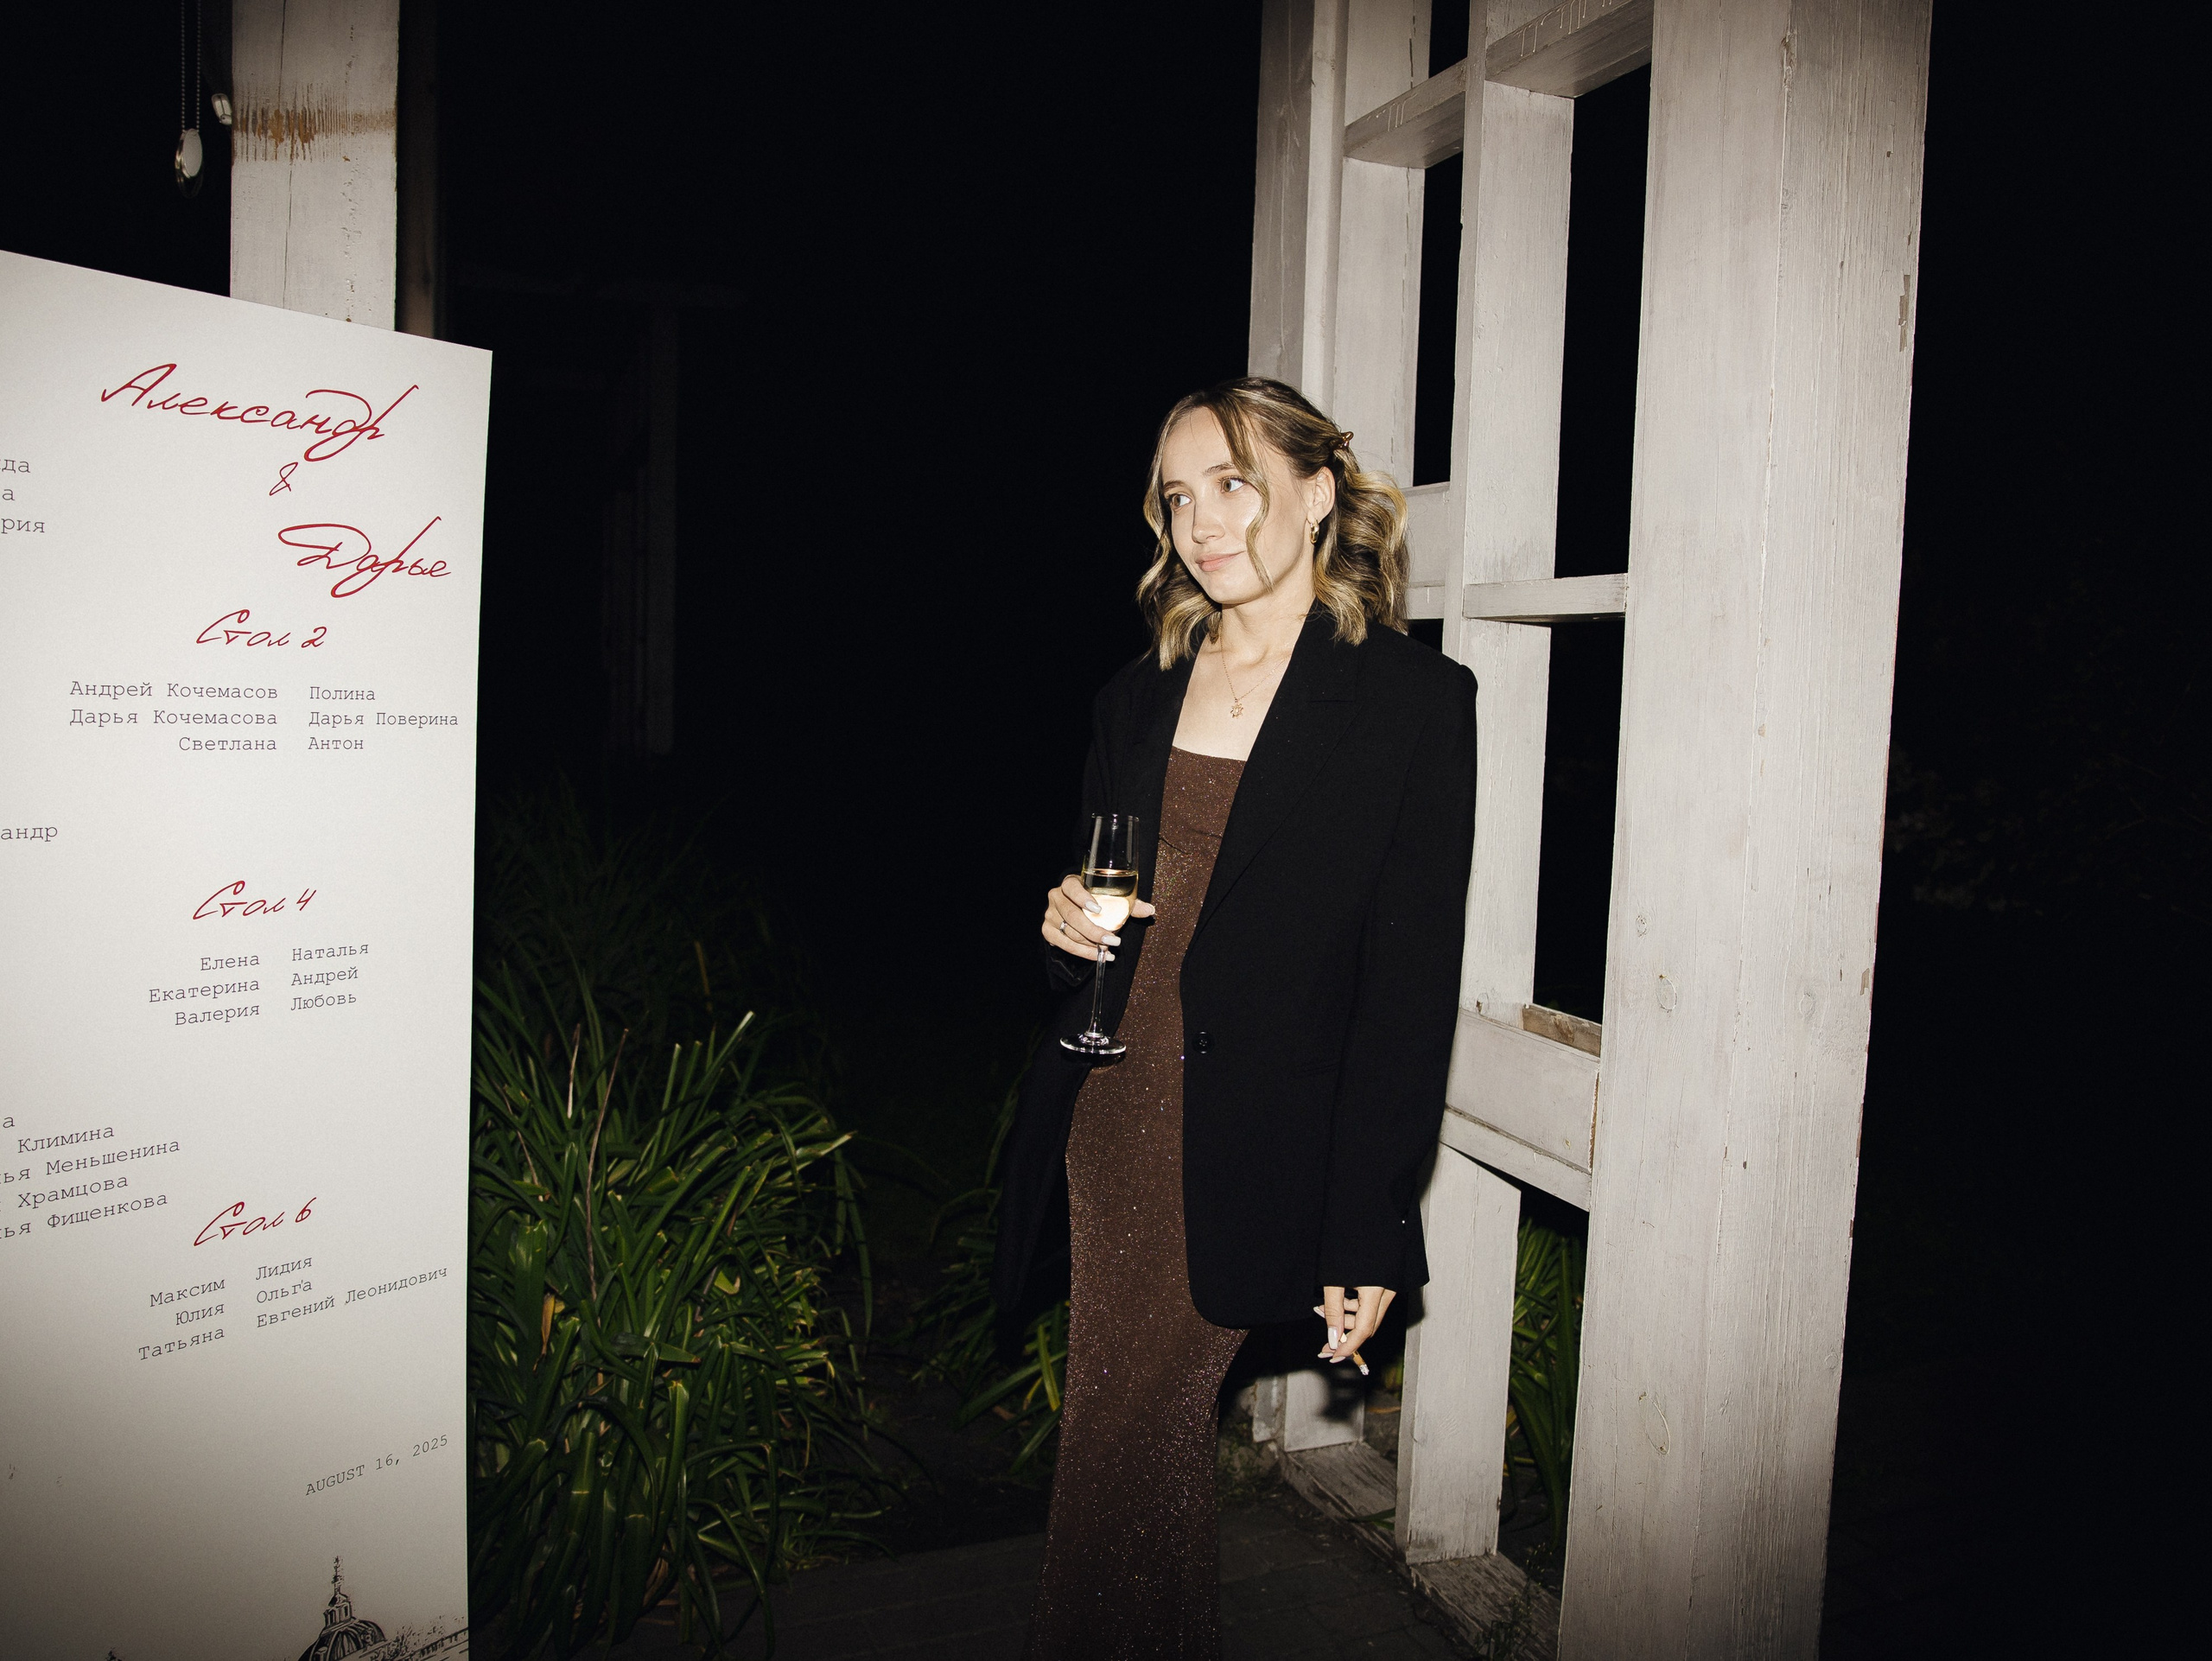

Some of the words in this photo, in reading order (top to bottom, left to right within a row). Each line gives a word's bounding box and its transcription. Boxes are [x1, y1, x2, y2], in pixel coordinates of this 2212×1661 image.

[101, 363, 419, 461] Александр
[0, 459, 30, 474] да
[269, 463, 298, 496] &
[196, 609, 291, 646] Стол
[301, 627, 327, 648] 2
[70, 681, 152, 700] Андрей
[167, 684, 277, 699] Кочемасов
[309, 686, 375, 700] Полина
[70, 710, 137, 727] Дарья
[154, 710, 276, 724] Кочемасова
[308, 712, 364, 728] Дарья
[376, 713, 458, 729] Поверина
[180, 737, 276, 750] Светлана
[308, 737, 364, 749] Антон
[193, 881, 286, 920] Стол
[296, 888, 316, 911] 4
[200, 955, 259, 971] Елена
[292, 943, 369, 961] Наталья
[291, 966, 359, 986] Андрей
[149, 980, 259, 1002] Екатерина
[291, 992, 357, 1010] Любовь
[175, 1005, 259, 1025] Валерия
[18, 1127, 114, 1153] Климина
[0, 1168, 30, 1184] ья
[47, 1142, 180, 1175] Меньшенина
[18, 1177, 128, 1209] Храмцова
[0, 1223, 31, 1238] ья
[48, 1195, 168, 1228] Фищенкова
[194, 1201, 285, 1246] Стол
[295, 1197, 317, 1223] 6
[256, 1257, 312, 1280] Лидия
[150, 1279, 225, 1307] Максим
[257, 1280, 312, 1303] Ольга
[257, 1295, 334, 1327] Евгений
[345, 1268, 448, 1305] Леонидович
[175, 1303, 225, 1327] Юлия
[138, 1328, 225, 1361] Татьяна
[306, 1465, 365, 1496] AUGUST
[376, 1454, 399, 1470] 16,
[412, 1434, 448, 1456] 2025
